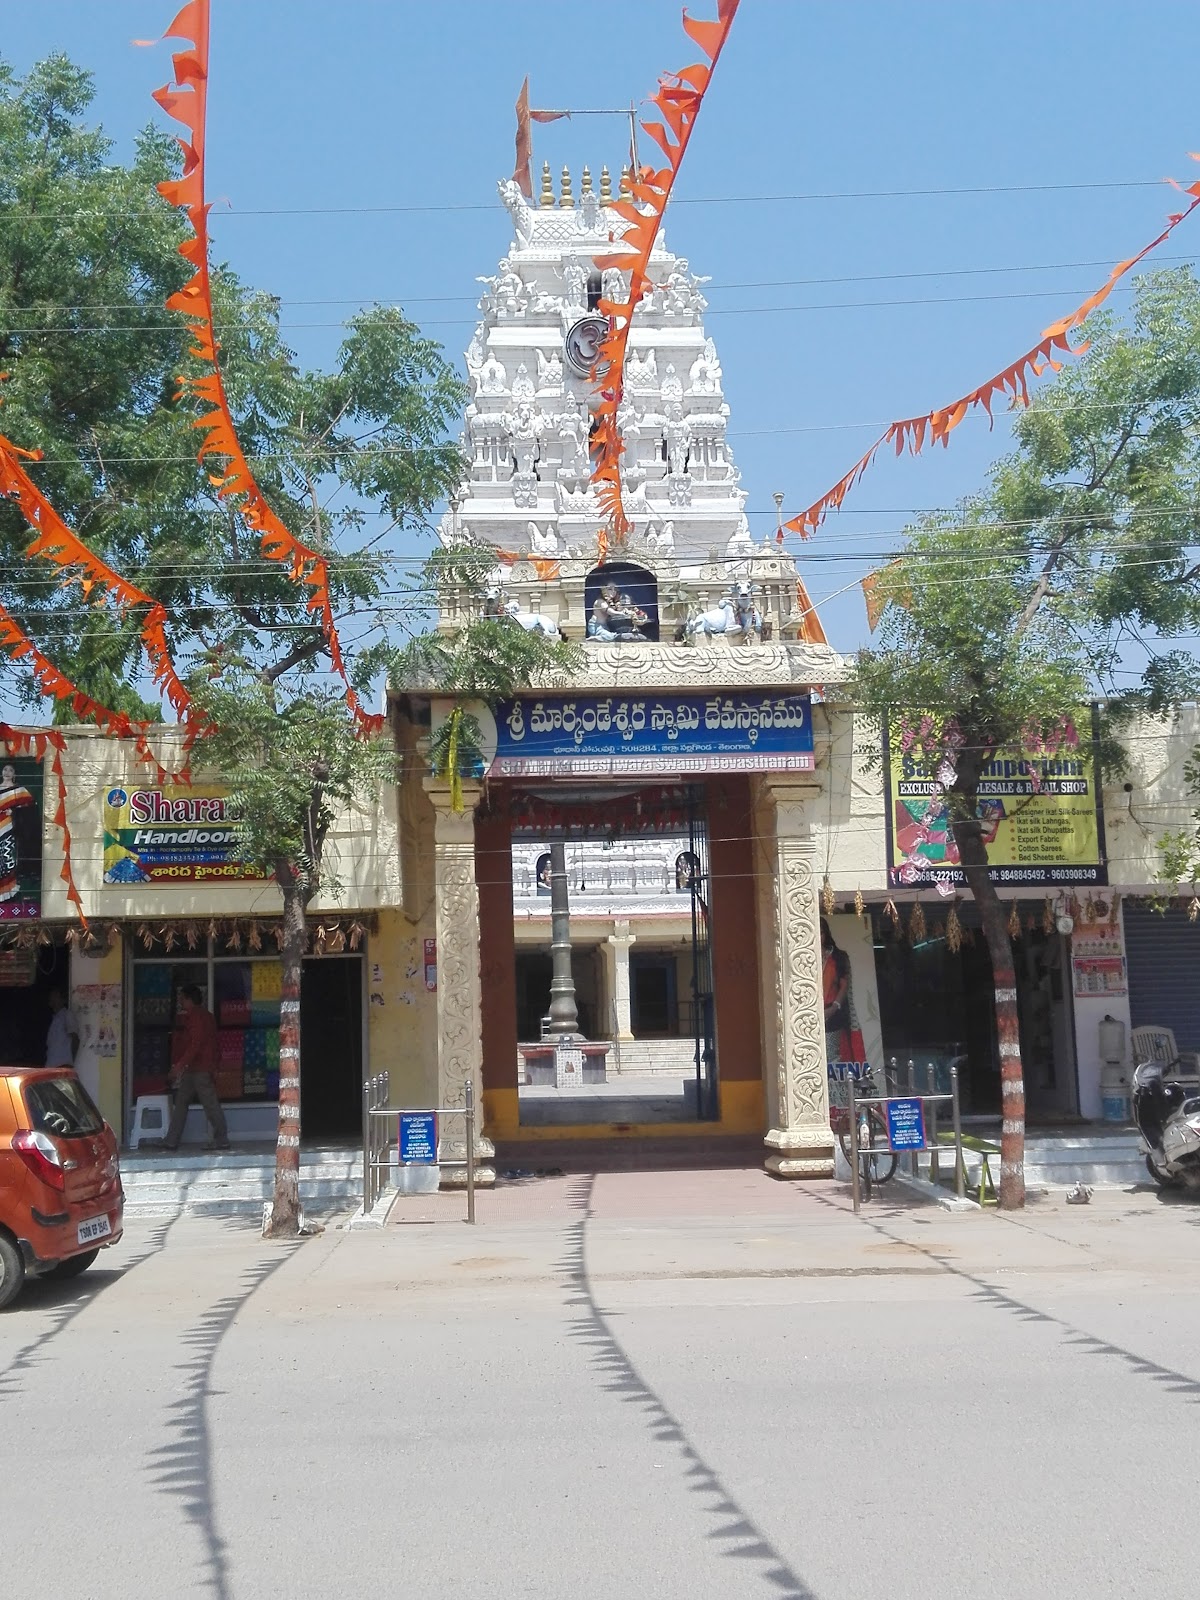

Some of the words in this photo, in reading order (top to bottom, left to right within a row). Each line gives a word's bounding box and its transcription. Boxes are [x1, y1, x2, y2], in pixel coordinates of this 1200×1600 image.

[506, 701, 526, 741] శ్రీ
[651, 703, 699, 740] స్వామి
[705, 696, 804, 745] దేవస్థానము
[501, 759, 522, 774] Sri
[1026, 782, 1059, 793] RTAIL
[1061, 781, 1087, 793] SHOP
[1017, 835, 1039, 844] Export
[1040, 835, 1060, 843] Fabric
[1041, 844, 1062, 852] Sarees
[1033, 853, 1055, 861] Sheets
[150, 866, 191, 877] శారద
[1000, 869, 1046, 880] 9848845492
[1050, 869, 1097, 879] 9603908349
